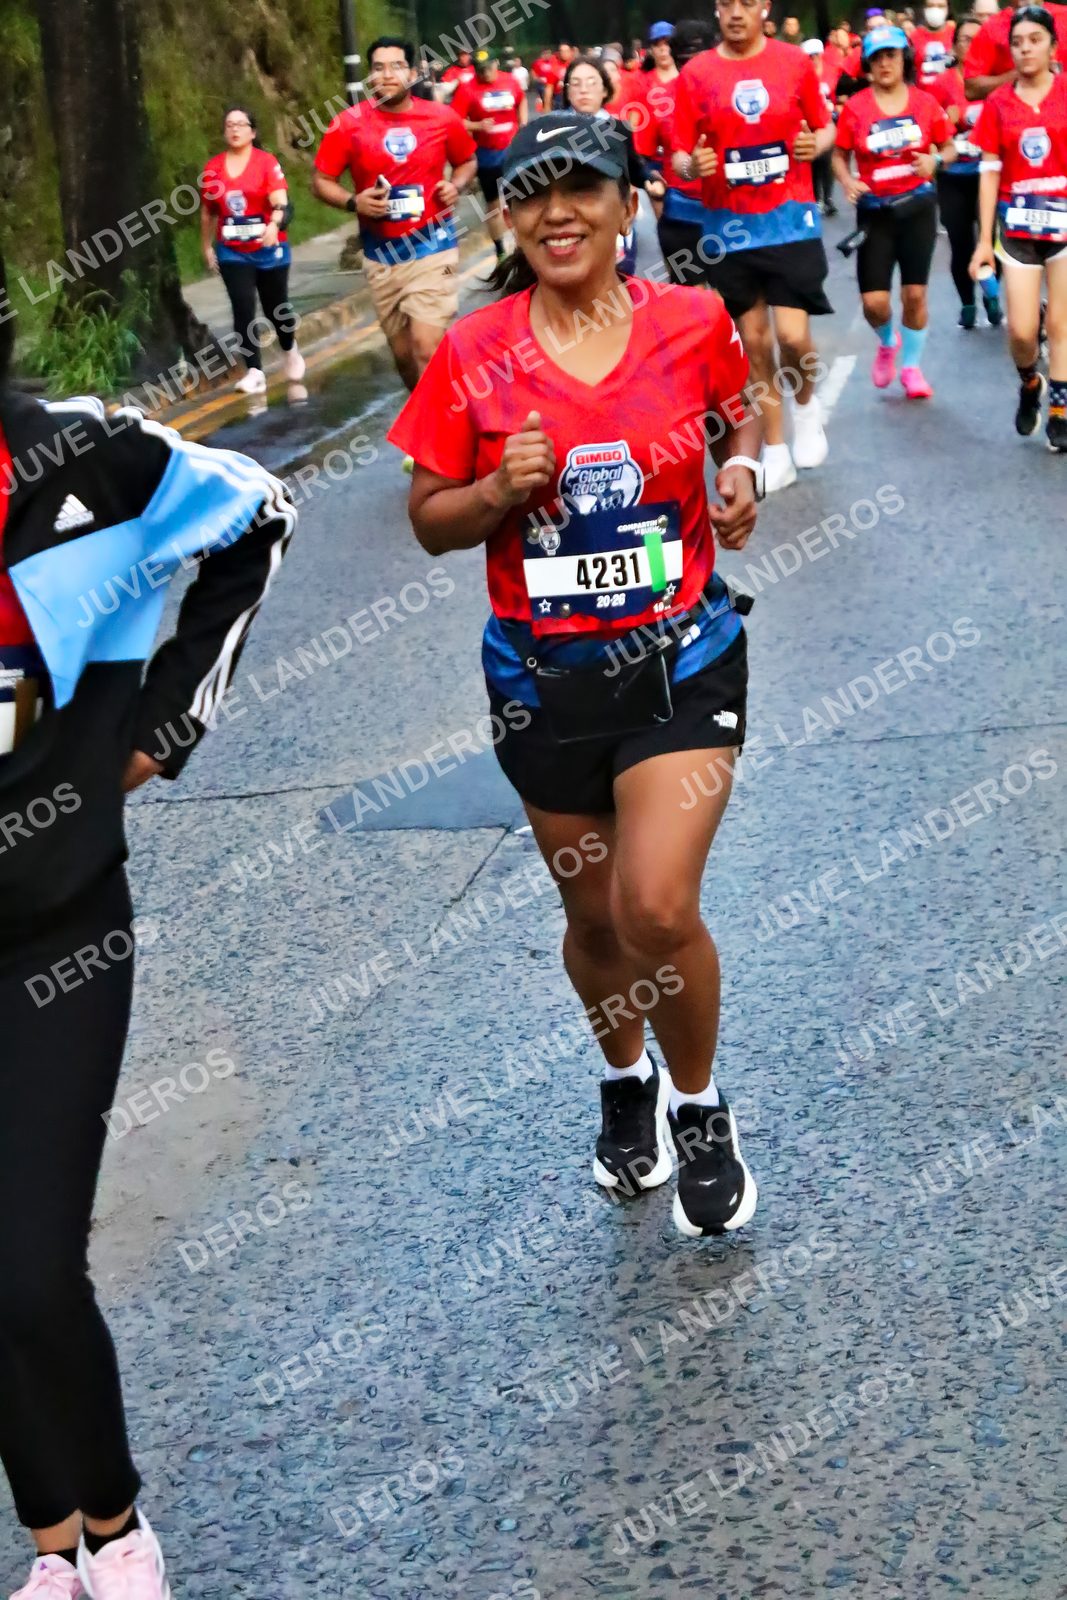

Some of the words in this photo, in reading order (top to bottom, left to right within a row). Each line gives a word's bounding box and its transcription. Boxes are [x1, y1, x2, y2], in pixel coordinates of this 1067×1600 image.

[575, 450, 622, 465] BIMBO
[578, 466, 623, 483] Global
[571, 482, 607, 496] Race
[576, 552, 642, 591] 4231
